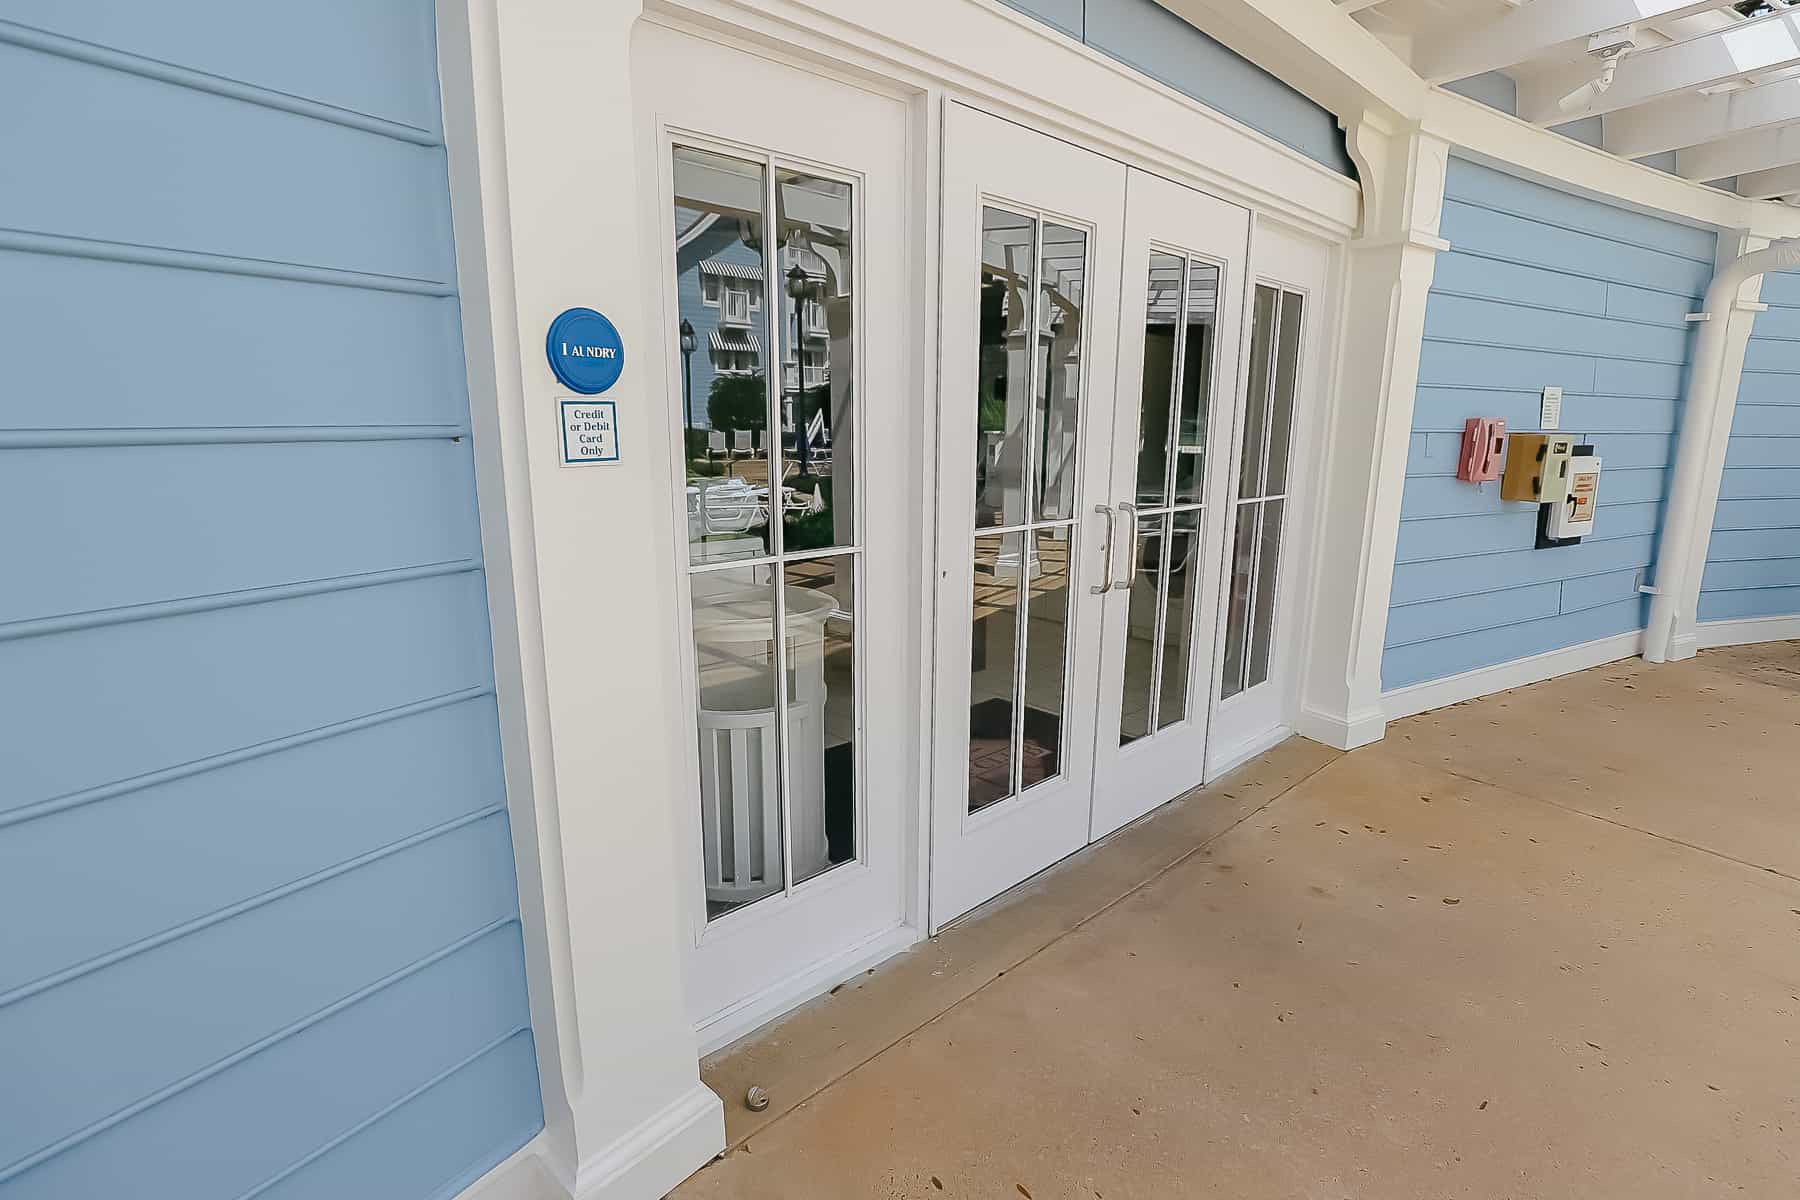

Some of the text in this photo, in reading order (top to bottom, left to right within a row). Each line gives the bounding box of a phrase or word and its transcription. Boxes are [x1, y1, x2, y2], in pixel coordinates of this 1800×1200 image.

[574, 409, 604, 419] Credit
[570, 422, 610, 431] or Debit
[579, 434, 603, 443] Card
[580, 446, 604, 456] Only
